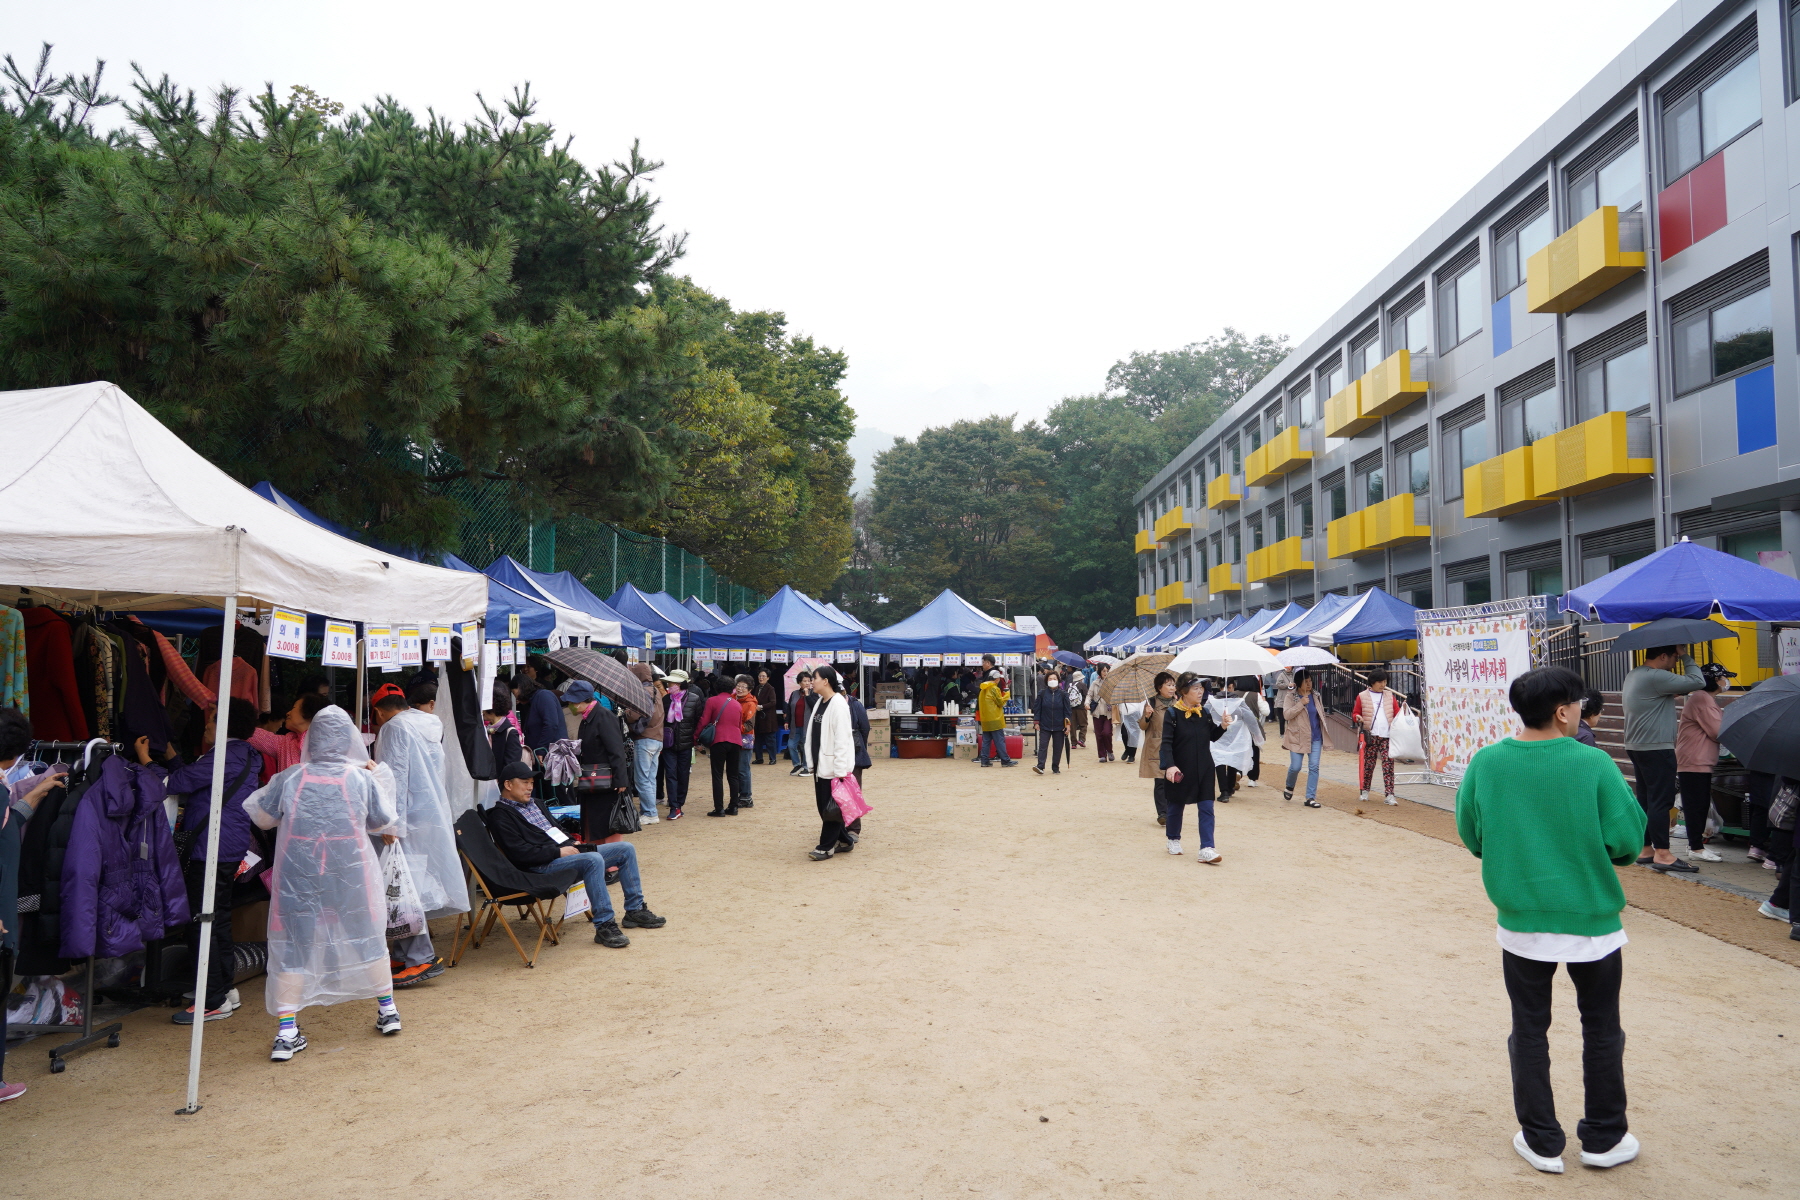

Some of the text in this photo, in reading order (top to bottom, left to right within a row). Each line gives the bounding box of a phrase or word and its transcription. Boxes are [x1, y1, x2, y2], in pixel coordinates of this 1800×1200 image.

[511, 617, 518, 634] 17
[276, 640, 300, 653] 3.000원
[1445, 657, 1507, 684] 사랑의 大바자회
